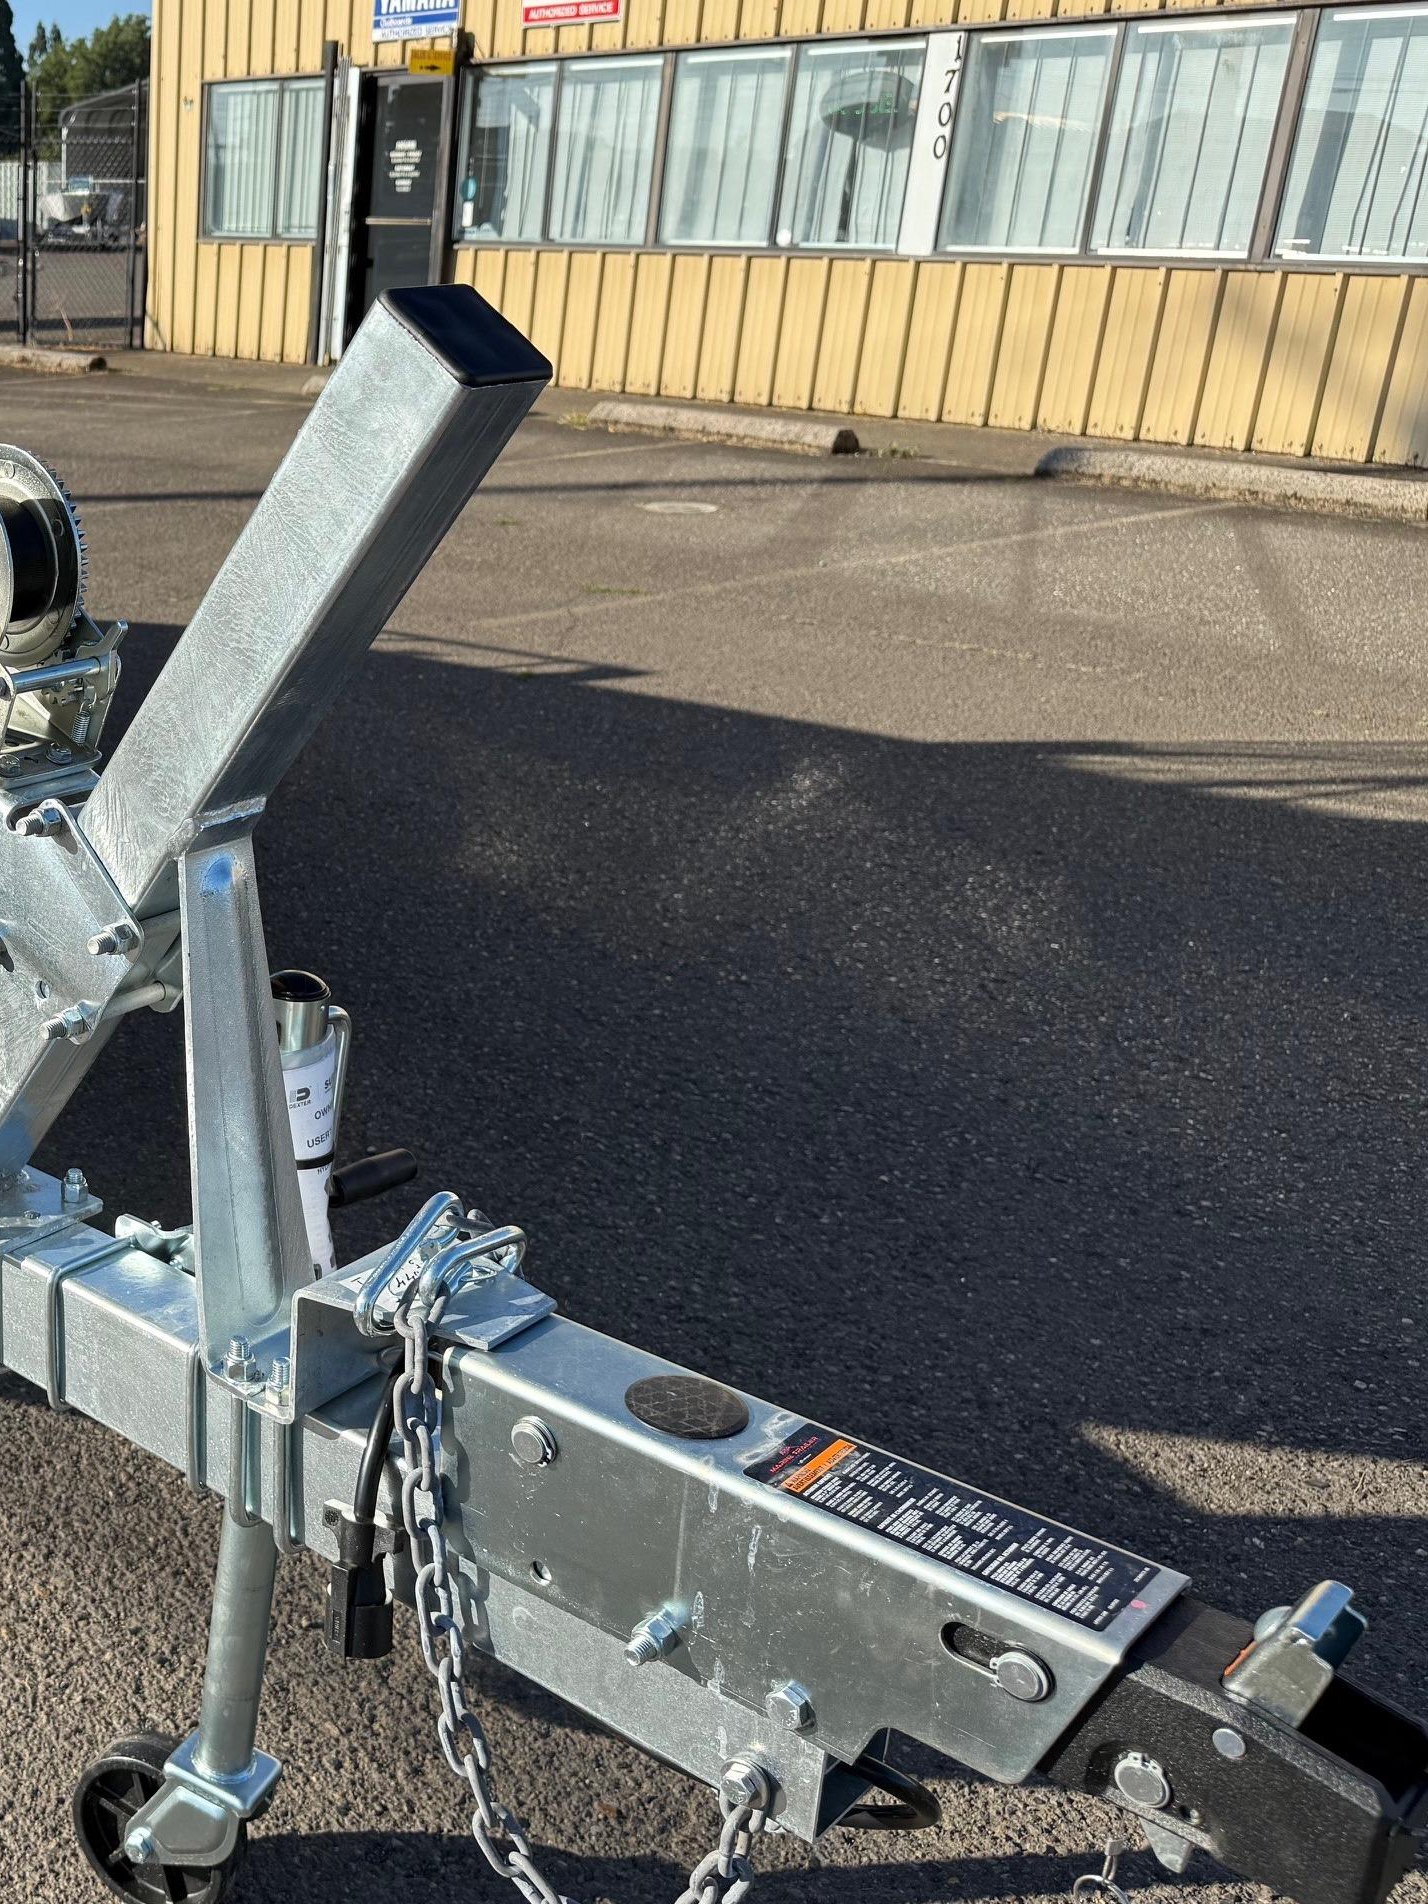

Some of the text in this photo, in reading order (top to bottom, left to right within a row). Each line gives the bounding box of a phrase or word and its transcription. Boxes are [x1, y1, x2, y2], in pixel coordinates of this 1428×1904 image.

[528, 1, 614, 20] AUTHORIZED SERVICE
[933, 34, 962, 160] 1700
